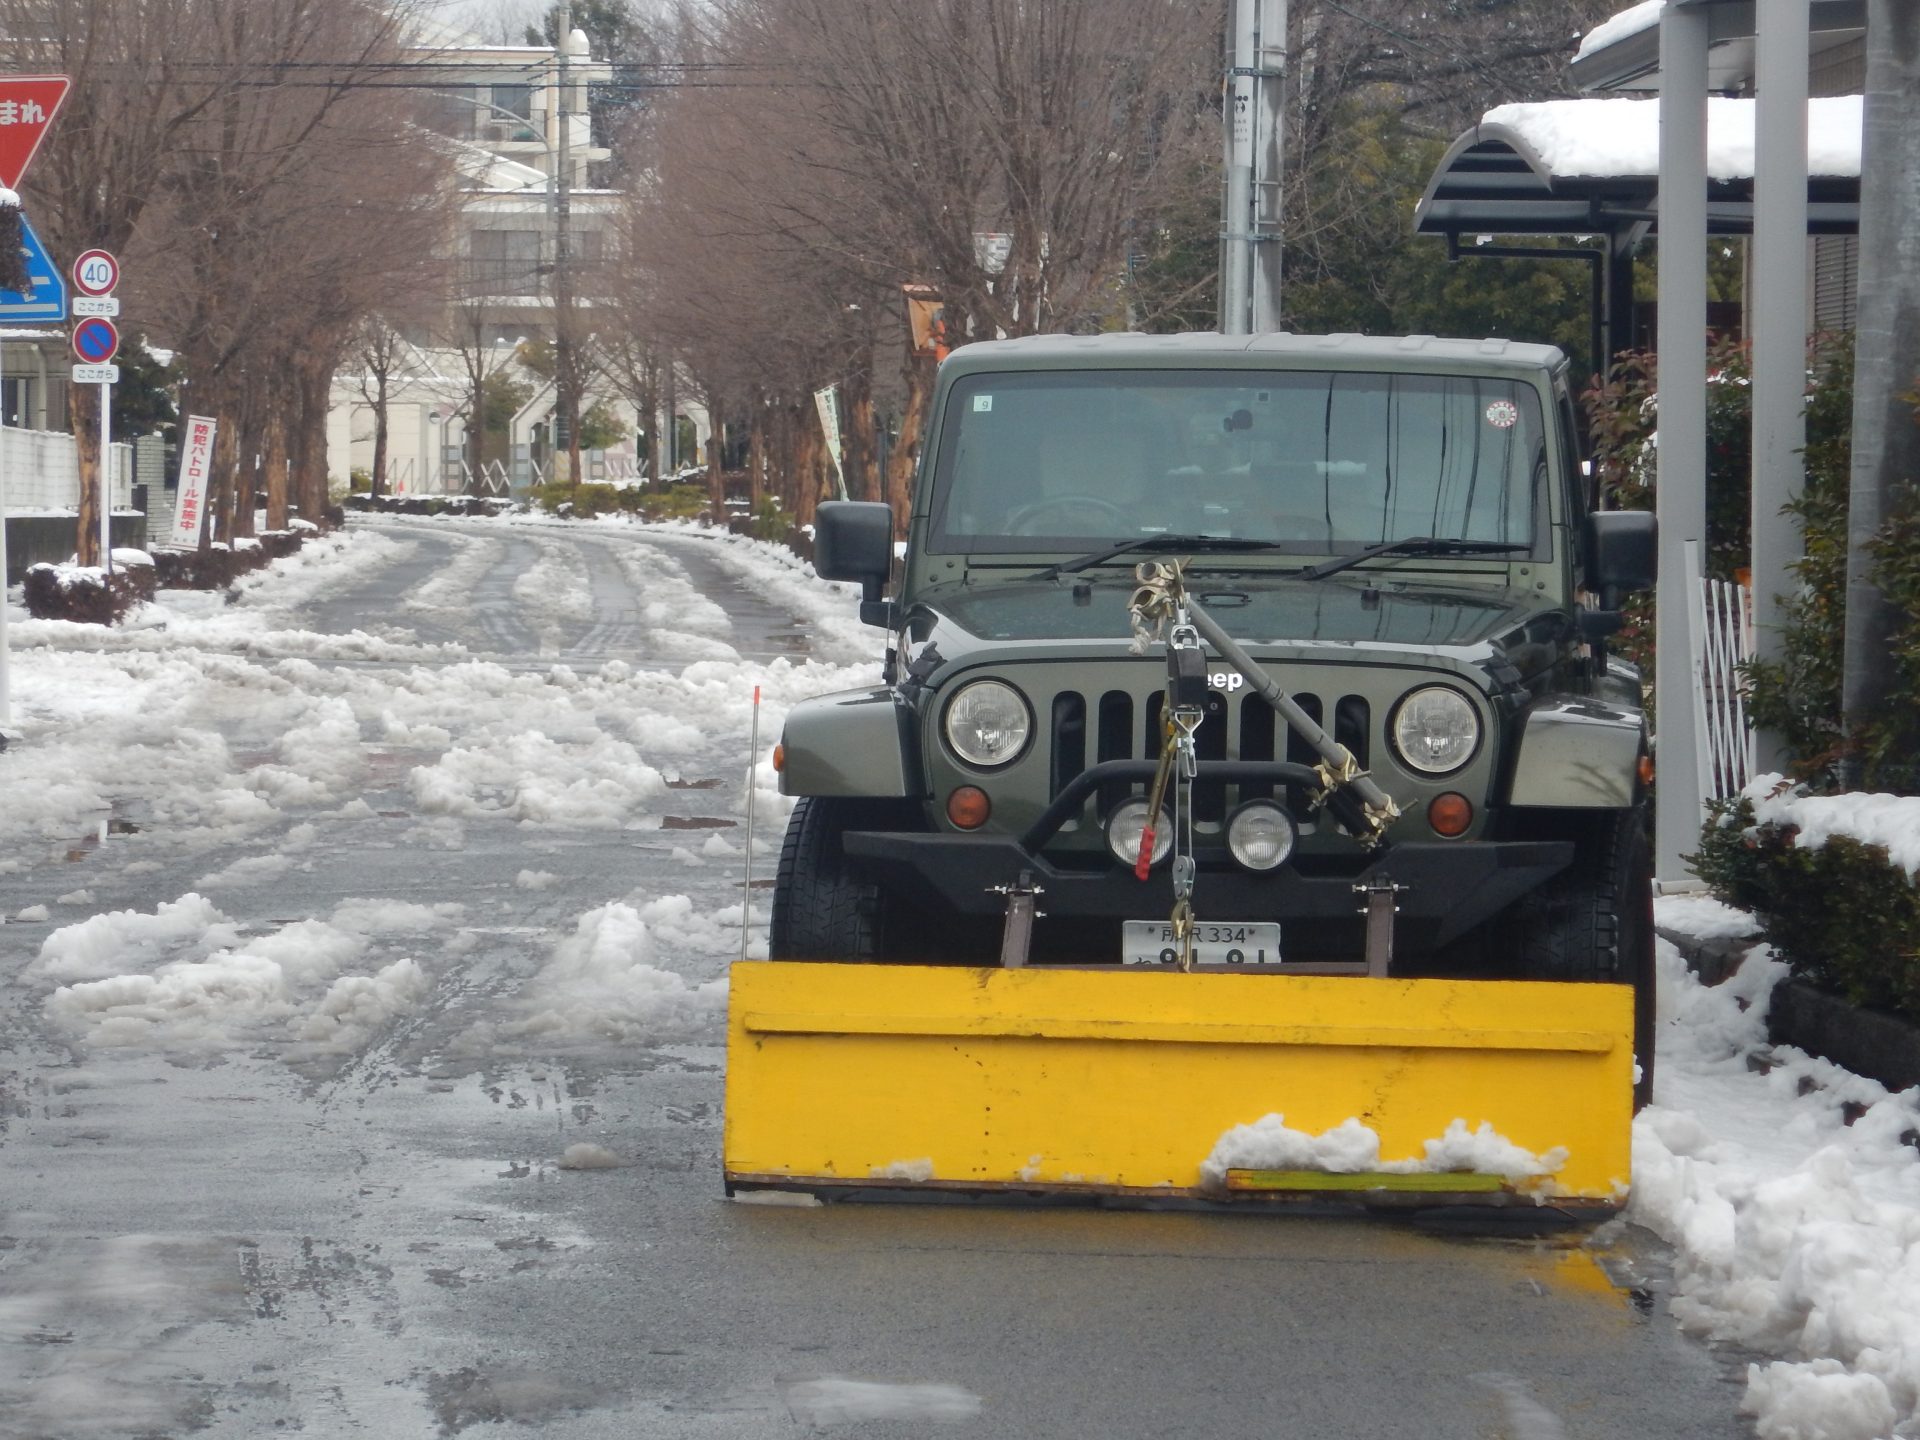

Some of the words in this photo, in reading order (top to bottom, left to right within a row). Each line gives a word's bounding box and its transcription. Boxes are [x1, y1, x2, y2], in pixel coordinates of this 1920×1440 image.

[85, 263, 109, 283] 40
[79, 302, 114, 313] ここから
[78, 369, 113, 379] ここから
[180, 424, 209, 530] 防犯パトロール実施中
[1208, 927, 1246, 943] 334
